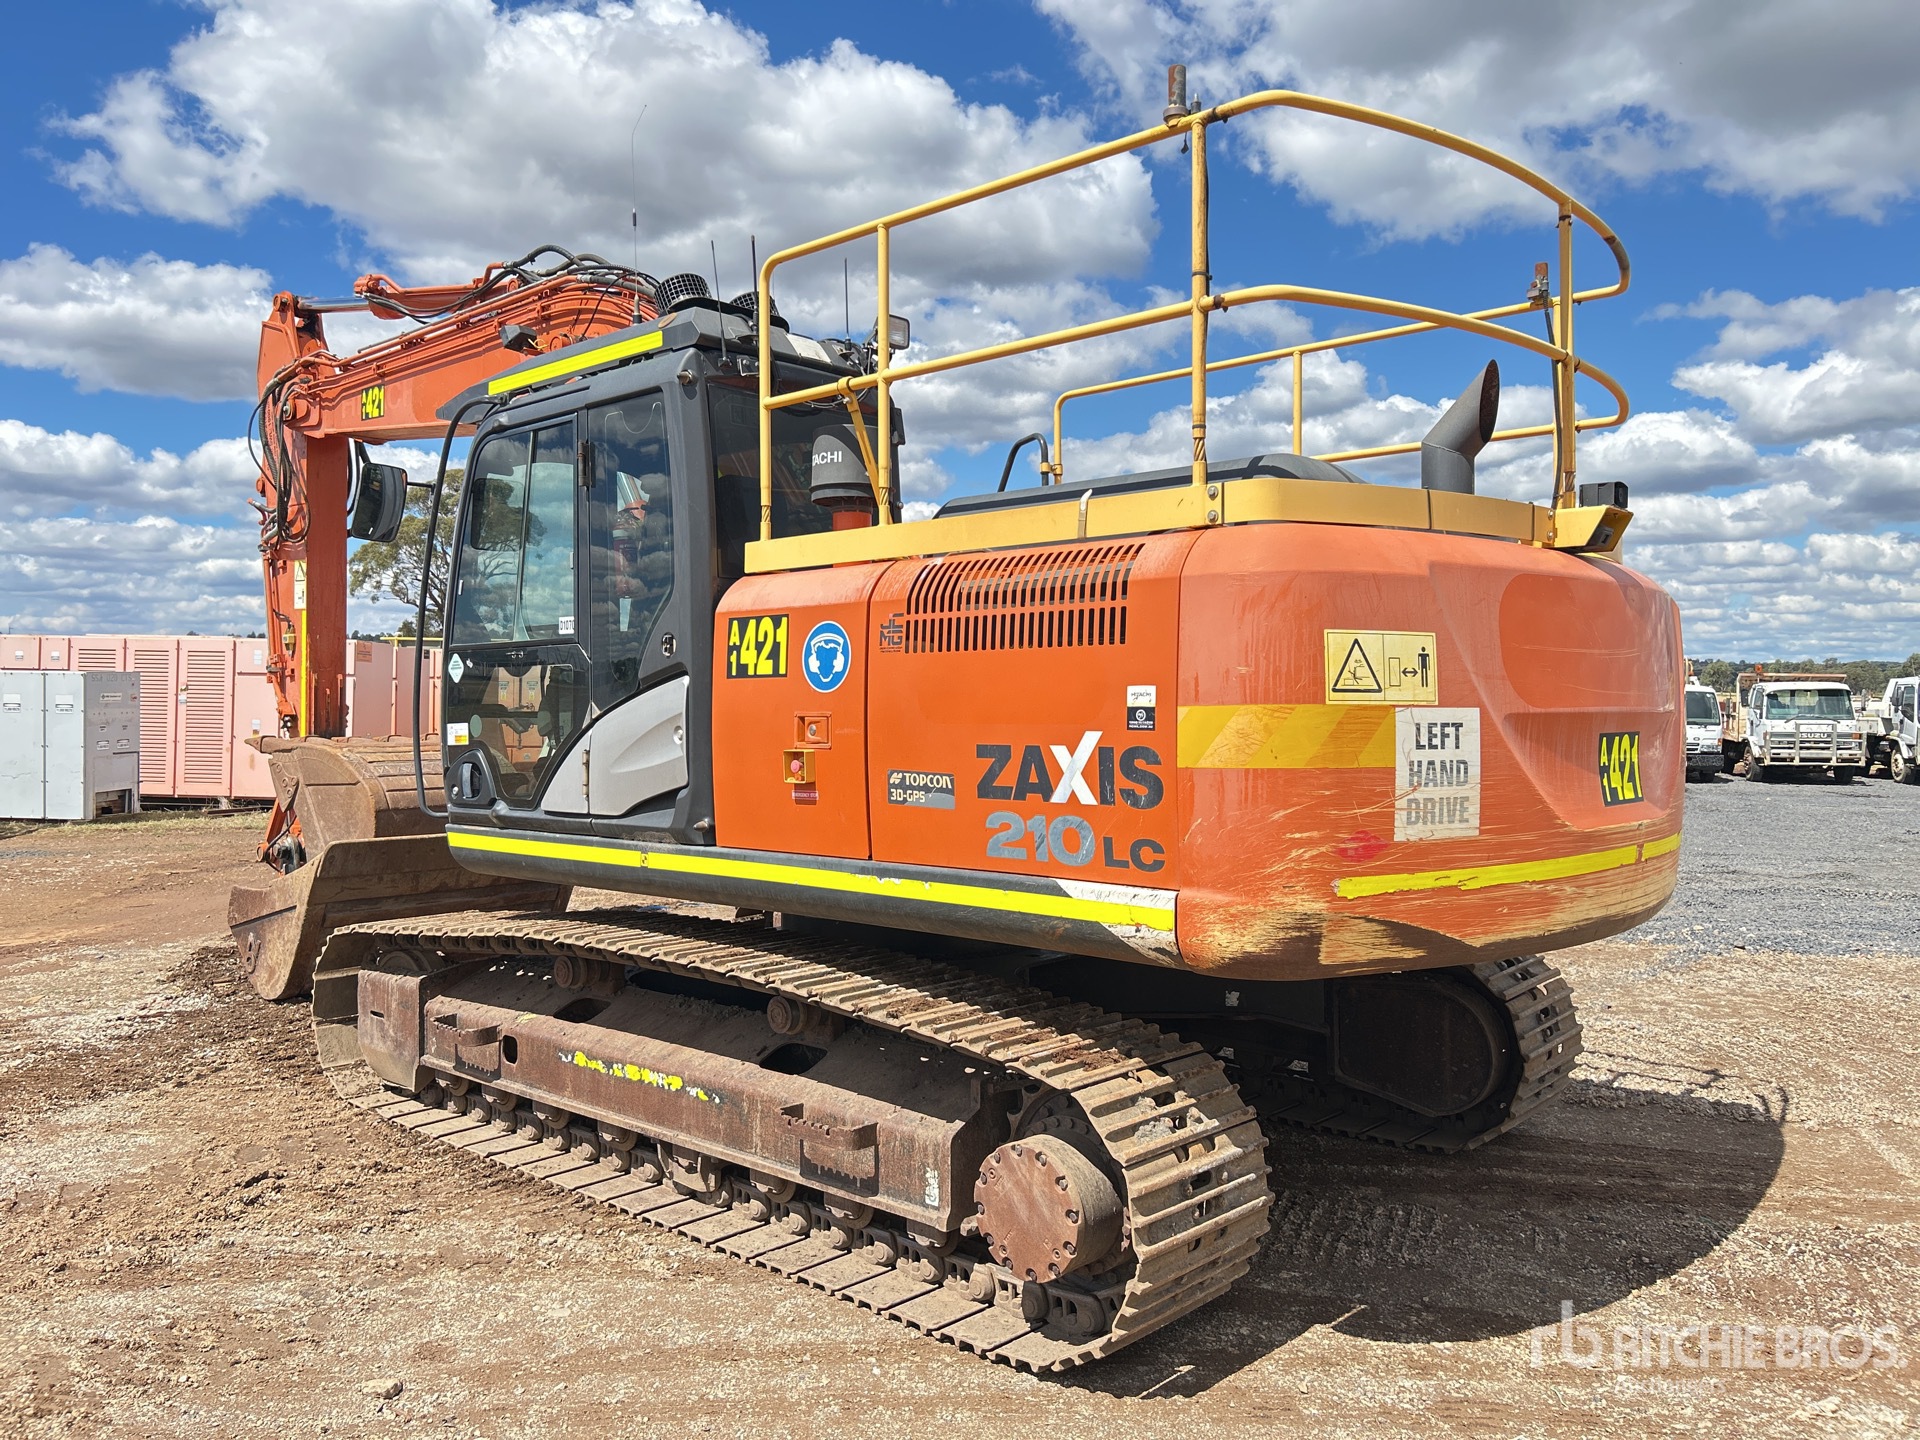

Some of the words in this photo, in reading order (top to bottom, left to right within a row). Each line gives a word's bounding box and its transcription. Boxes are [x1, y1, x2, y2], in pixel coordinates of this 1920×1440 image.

[366, 386, 384, 418] 421
[740, 617, 788, 675] 421
[1415, 722, 1463, 750] LEFT
[903, 772, 952, 788] TOPCON
[975, 730, 1164, 810] ZAXIS
[1408, 760, 1468, 788] HAND
[1610, 734, 1642, 800] 421
[890, 788, 926, 802] 3D-GPS
[1406, 796, 1470, 825] DRIVE
[985, 811, 1096, 867] 210
[1102, 836, 1166, 873] LC
